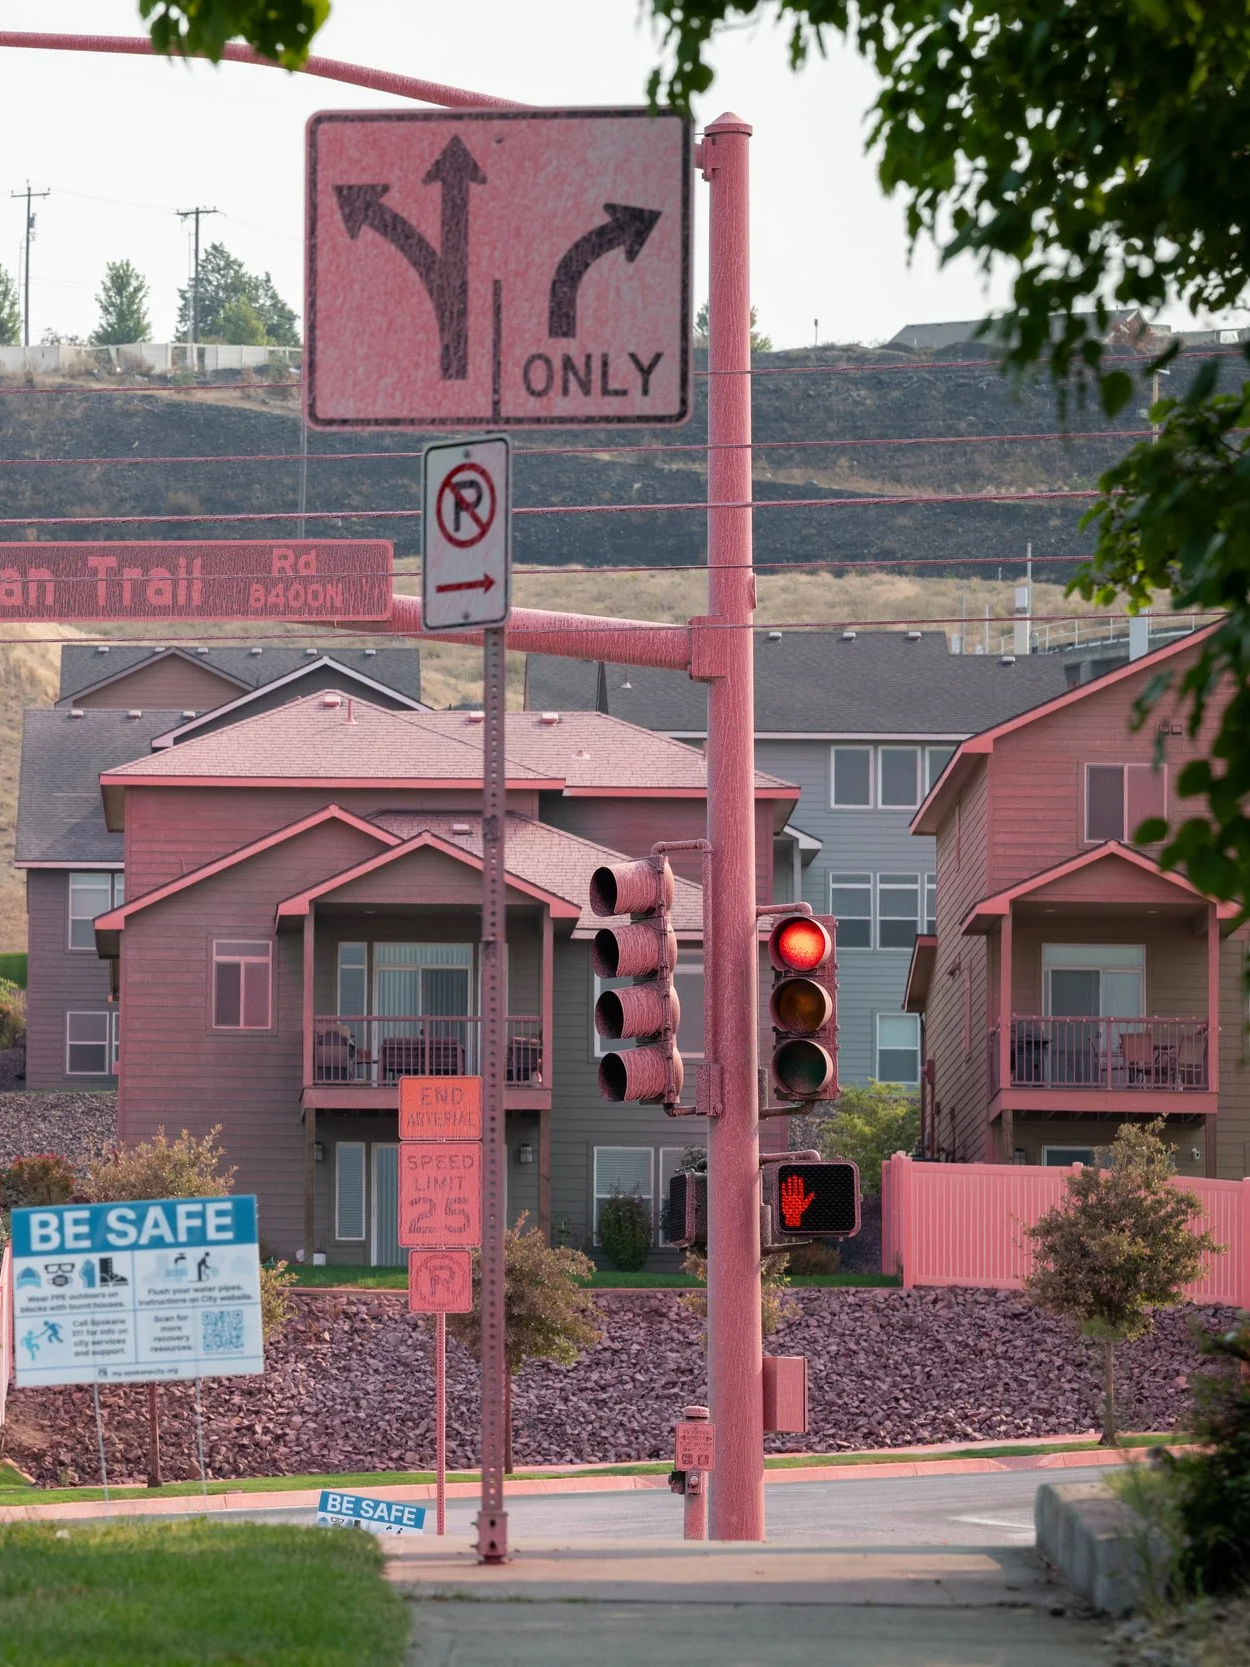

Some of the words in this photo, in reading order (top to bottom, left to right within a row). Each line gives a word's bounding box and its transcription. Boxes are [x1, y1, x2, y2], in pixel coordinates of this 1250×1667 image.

[522, 351, 664, 398] ONLY
[271, 547, 317, 576] Rd
[87, 554, 203, 607] Trail
[250, 583, 343, 609] 8400N
[420, 1086, 464, 1106] END
[406, 1110, 476, 1128] ARTERIAL
[406, 1154, 475, 1171] SPEED
[414, 1175, 466, 1192] LIMIT
[28, 1210, 92, 1252] BE
[105, 1201, 235, 1247] SAFE
[408, 1197, 471, 1234] 25
[154, 1314, 175, 1323] Scan
[326, 1493, 356, 1515] BE
[359, 1500, 417, 1525] SAFE
